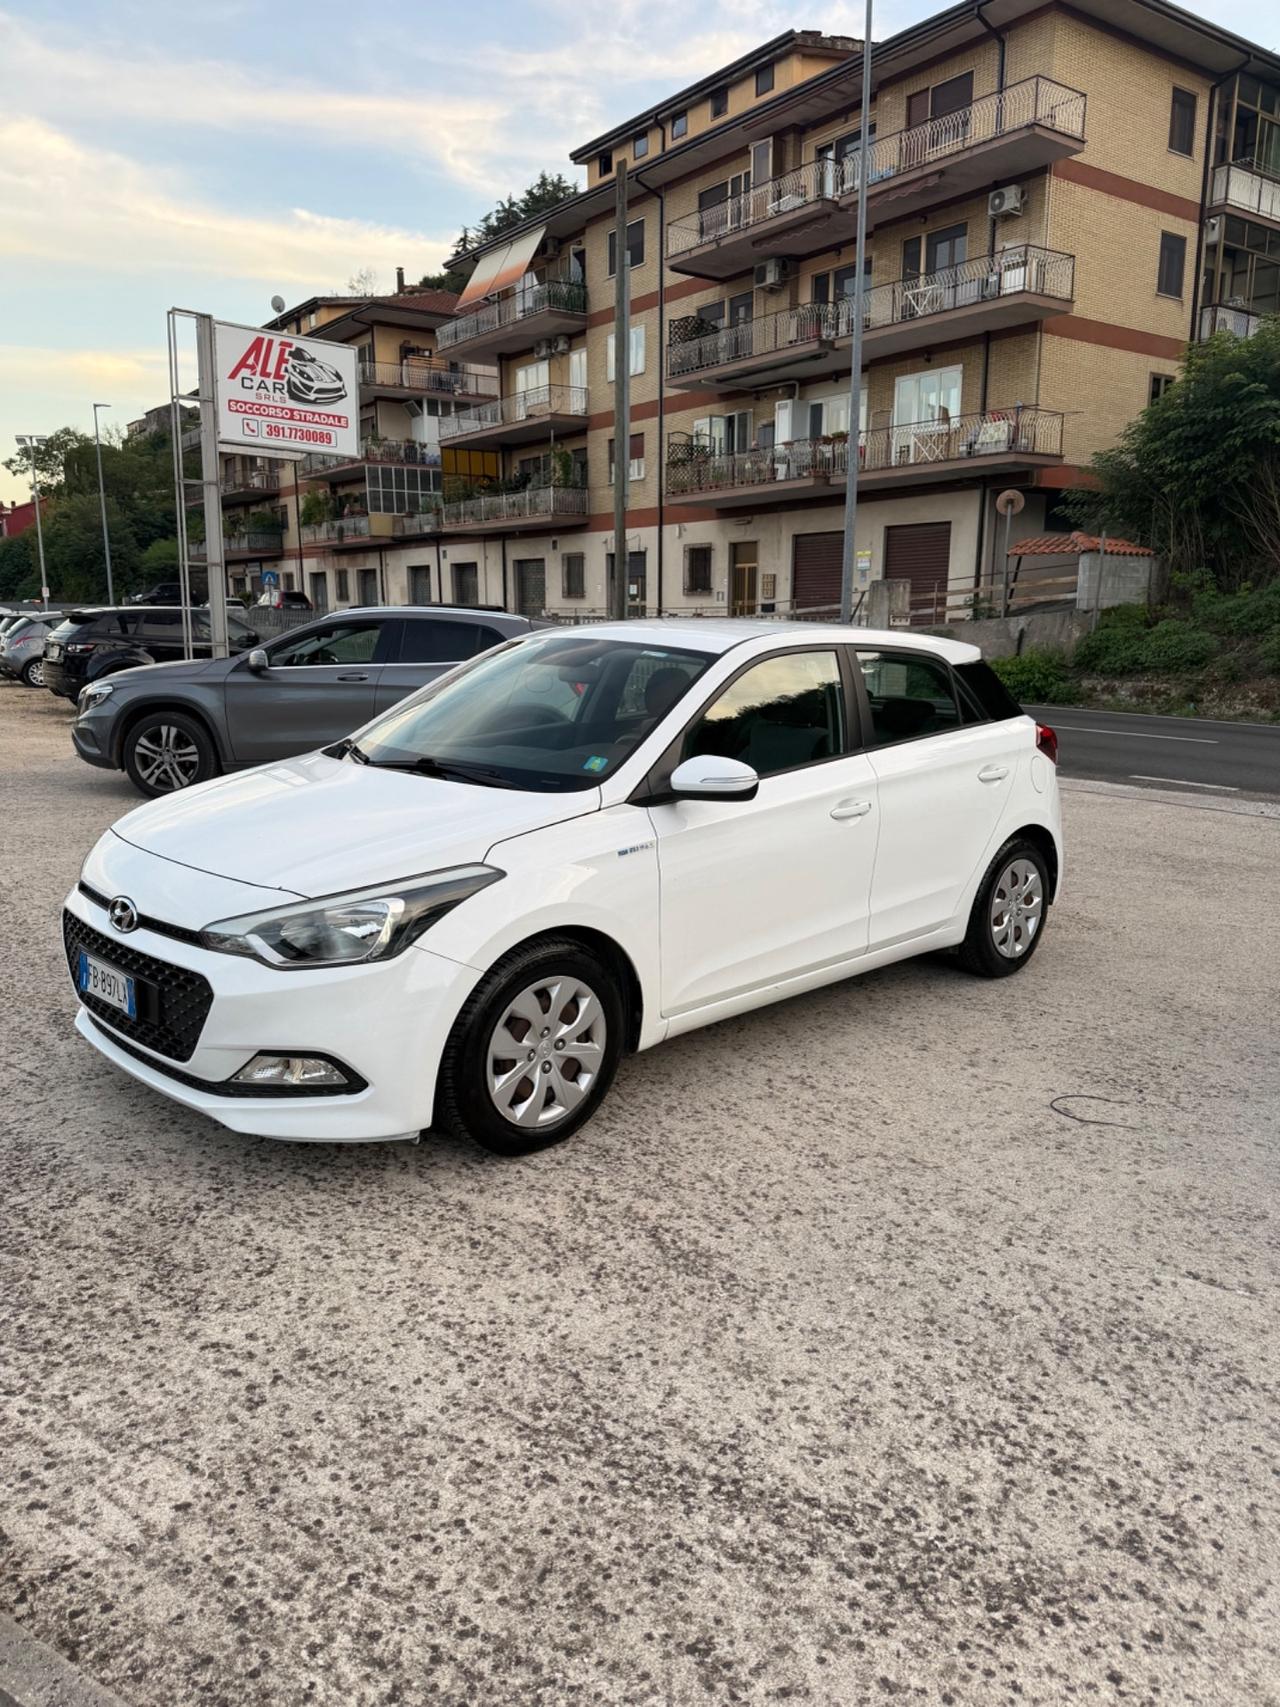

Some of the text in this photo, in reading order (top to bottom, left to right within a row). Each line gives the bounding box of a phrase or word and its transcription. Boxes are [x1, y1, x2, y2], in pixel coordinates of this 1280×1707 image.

[227, 336, 293, 381] ALE
[241, 376, 286, 395] CAR
[255, 392, 287, 404] SRLS
[229, 401, 348, 427] SOCCORSO STRADALE
[266, 424, 333, 445] 391.7730089
